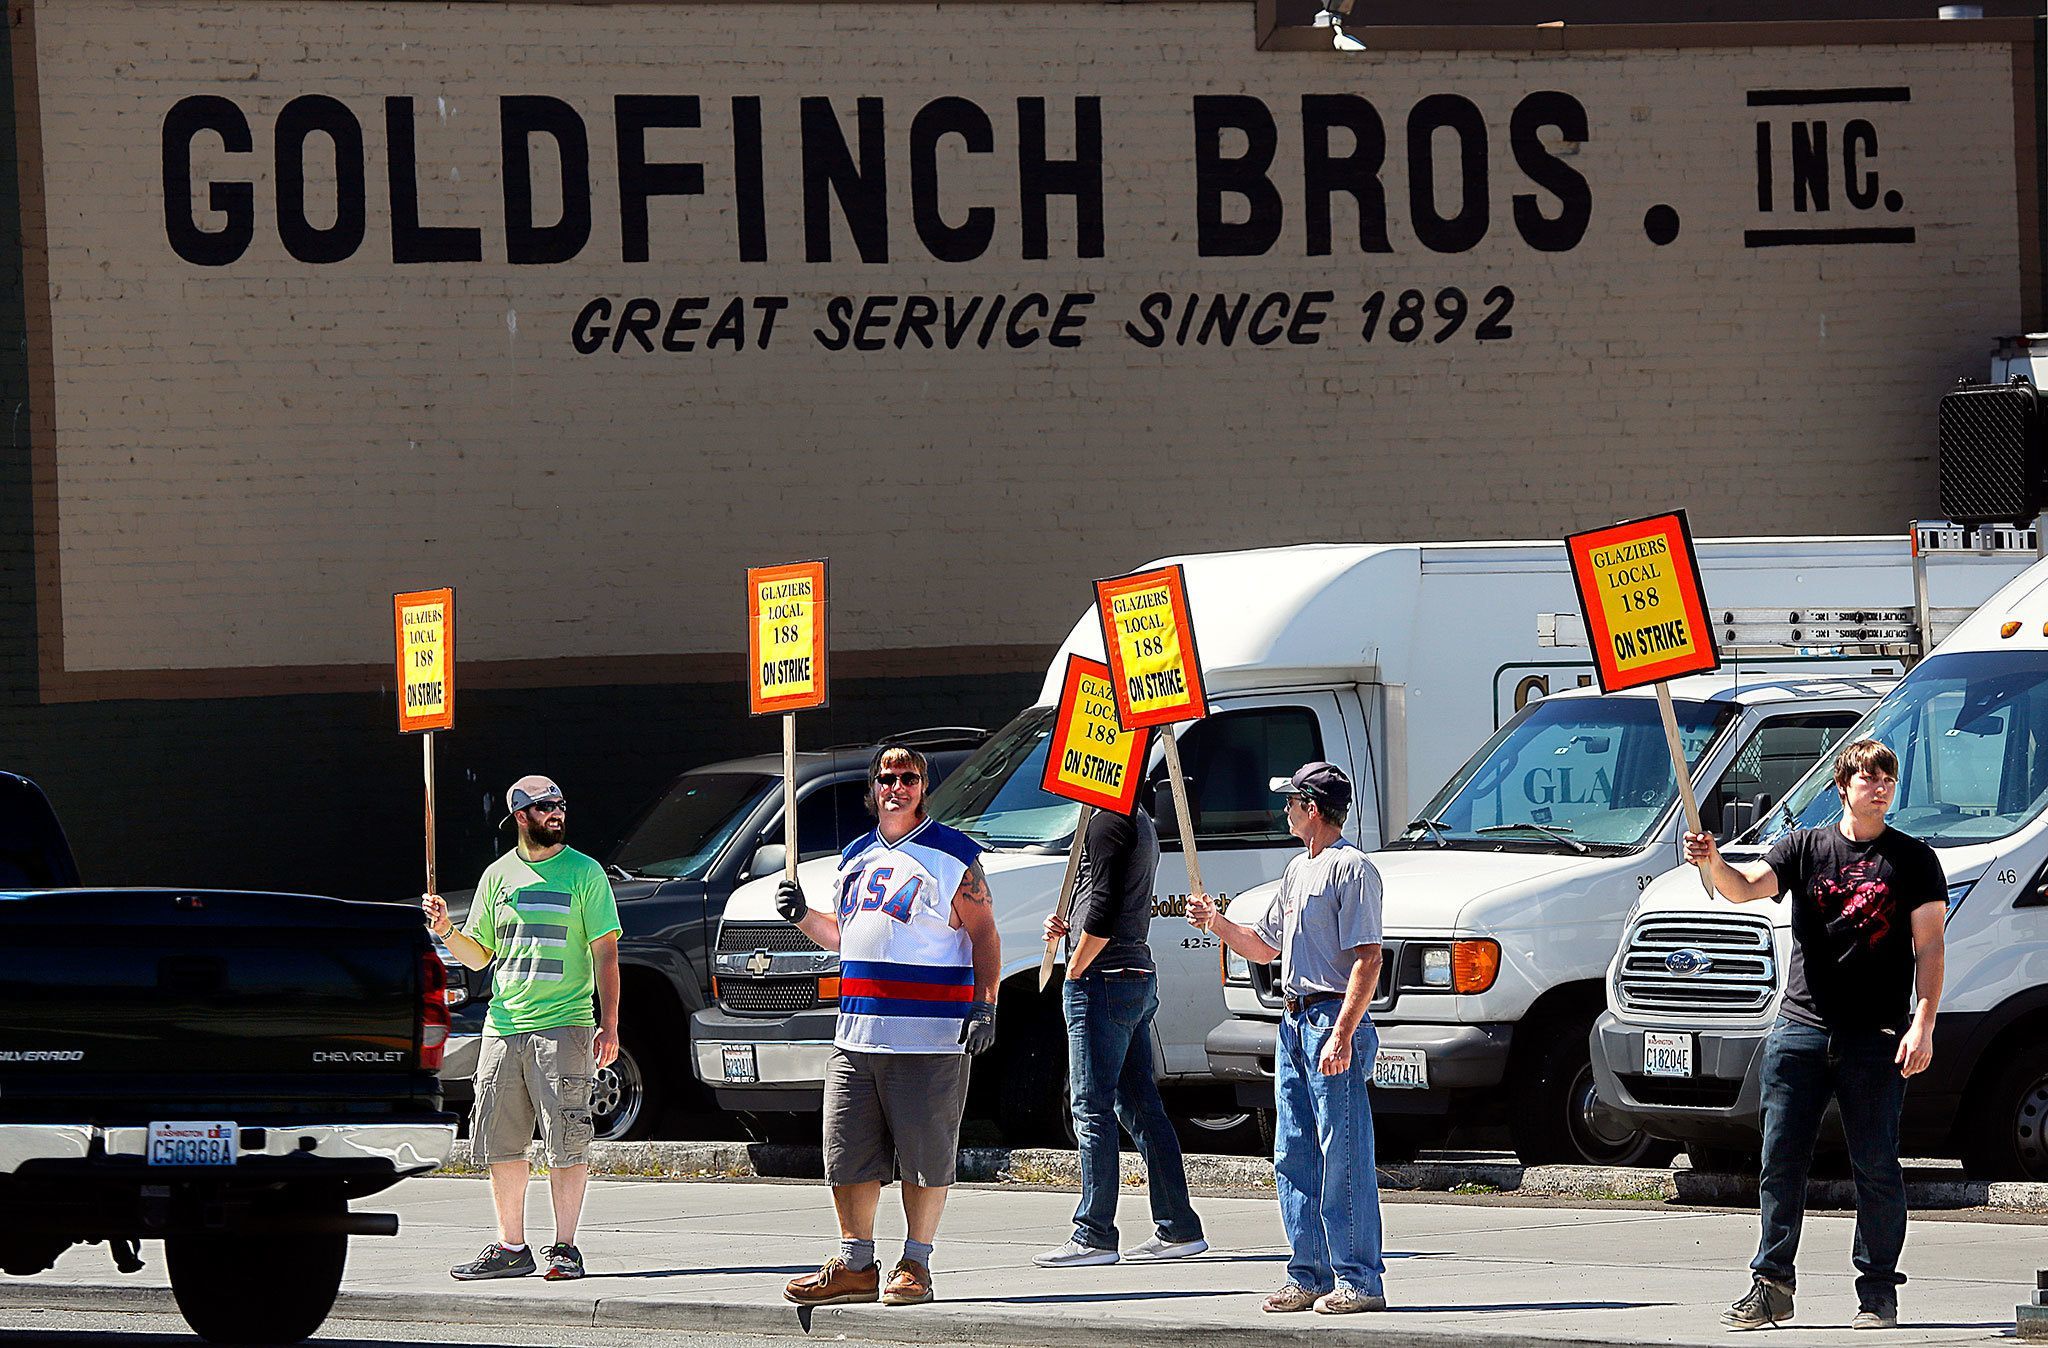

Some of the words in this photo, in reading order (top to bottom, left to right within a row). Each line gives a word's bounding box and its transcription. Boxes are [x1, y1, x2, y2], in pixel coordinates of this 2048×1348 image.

[1757, 118, 1904, 212] INC.
[162, 94, 1105, 266] GOLDFINCH
[1193, 90, 1680, 257] BROS.
[571, 296, 788, 354] GREAT
[813, 293, 1096, 351] SERVICE
[1125, 290, 1335, 348] SINCE
[1360, 285, 1515, 344] 1892
[1594, 538, 1667, 568] GLAZIERS
[1608, 563, 1661, 589] LOCAL
[761, 581, 811, 601] GLAZIERS
[1114, 590, 1169, 614] GLAZIERS
[1621, 587, 1660, 614] 188
[404, 610, 443, 625] GLAZIERS
[768, 603, 803, 620] LOCAL
[1124, 613, 1164, 634] LOCAL
[410, 629, 437, 645] LOCAL
[774, 624, 799, 644] 188
[1614, 631, 1637, 661] ON
[1637, 619, 1688, 656] STRIKE
[415, 649, 434, 667] 188
[1135, 635, 1163, 659] 188
[763, 661, 776, 687] ON
[777, 657, 810, 685] STRIKE
[407, 683, 417, 707] ON
[417, 681, 442, 707] STRIKE
[1081, 679, 1114, 701] GLAZ
[1128, 674, 1146, 703] ON
[1146, 668, 1185, 701] STRIKE
[1084, 700, 1118, 723] LOCA
[1085, 721, 1117, 746] 188
[1064, 748, 1081, 773] ON
[1081, 753, 1124, 788] STRIKE
[1997, 869, 2017, 885] 46
[841, 867, 923, 924] USA
[1180, 937, 1221, 949] 425-
[312, 1051, 405, 1062] CHEVROLET
[1646, 1047, 1689, 1070] C18204E
[153, 1139, 232, 1165] C50368A
